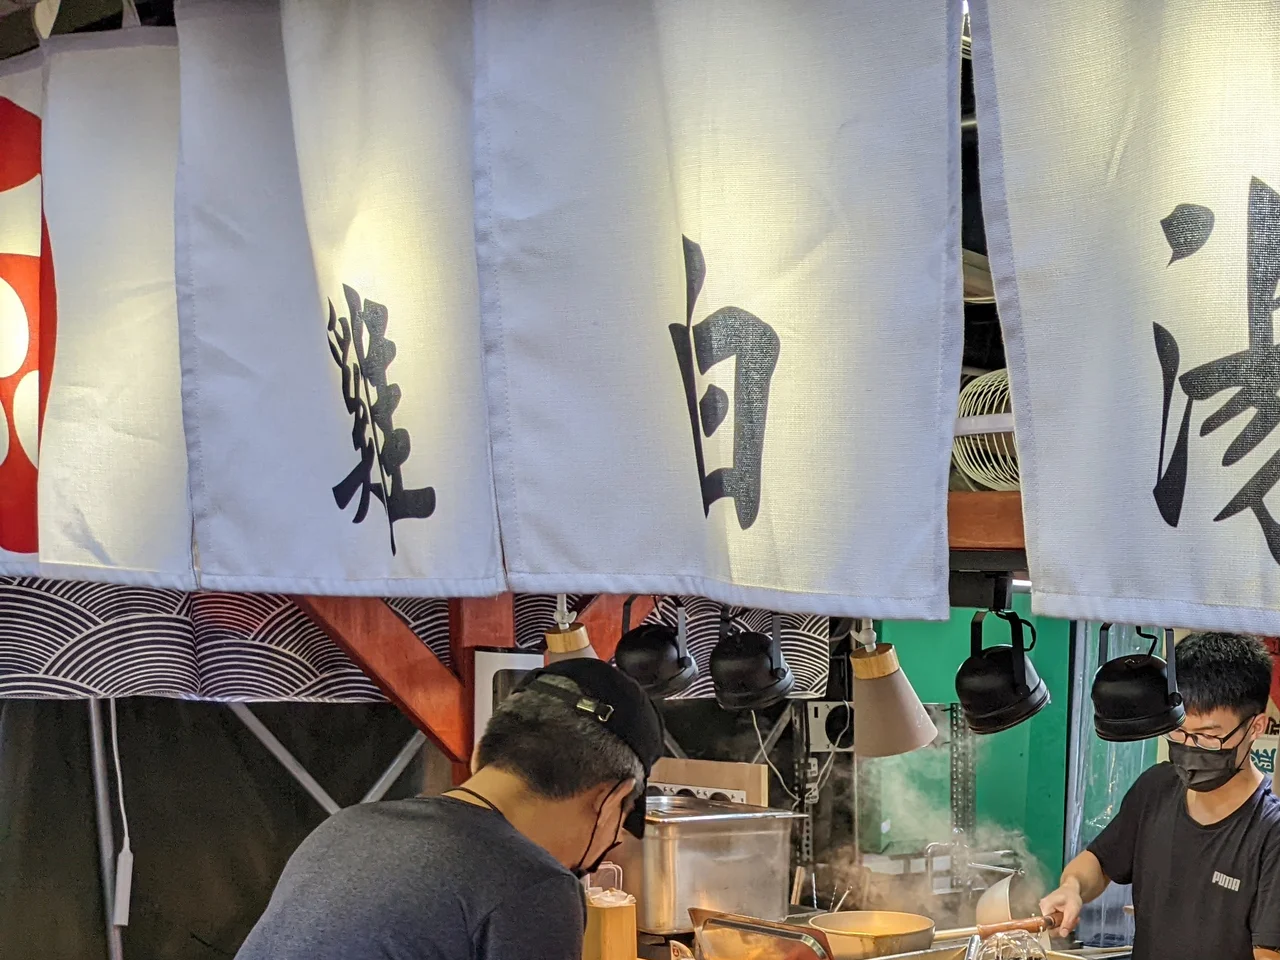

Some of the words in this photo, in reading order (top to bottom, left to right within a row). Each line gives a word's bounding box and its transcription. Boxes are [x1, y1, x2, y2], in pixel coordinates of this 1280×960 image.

[326, 283, 436, 557] 雞
[668, 233, 782, 531] 白
[1212, 870, 1241, 892] PUMA
